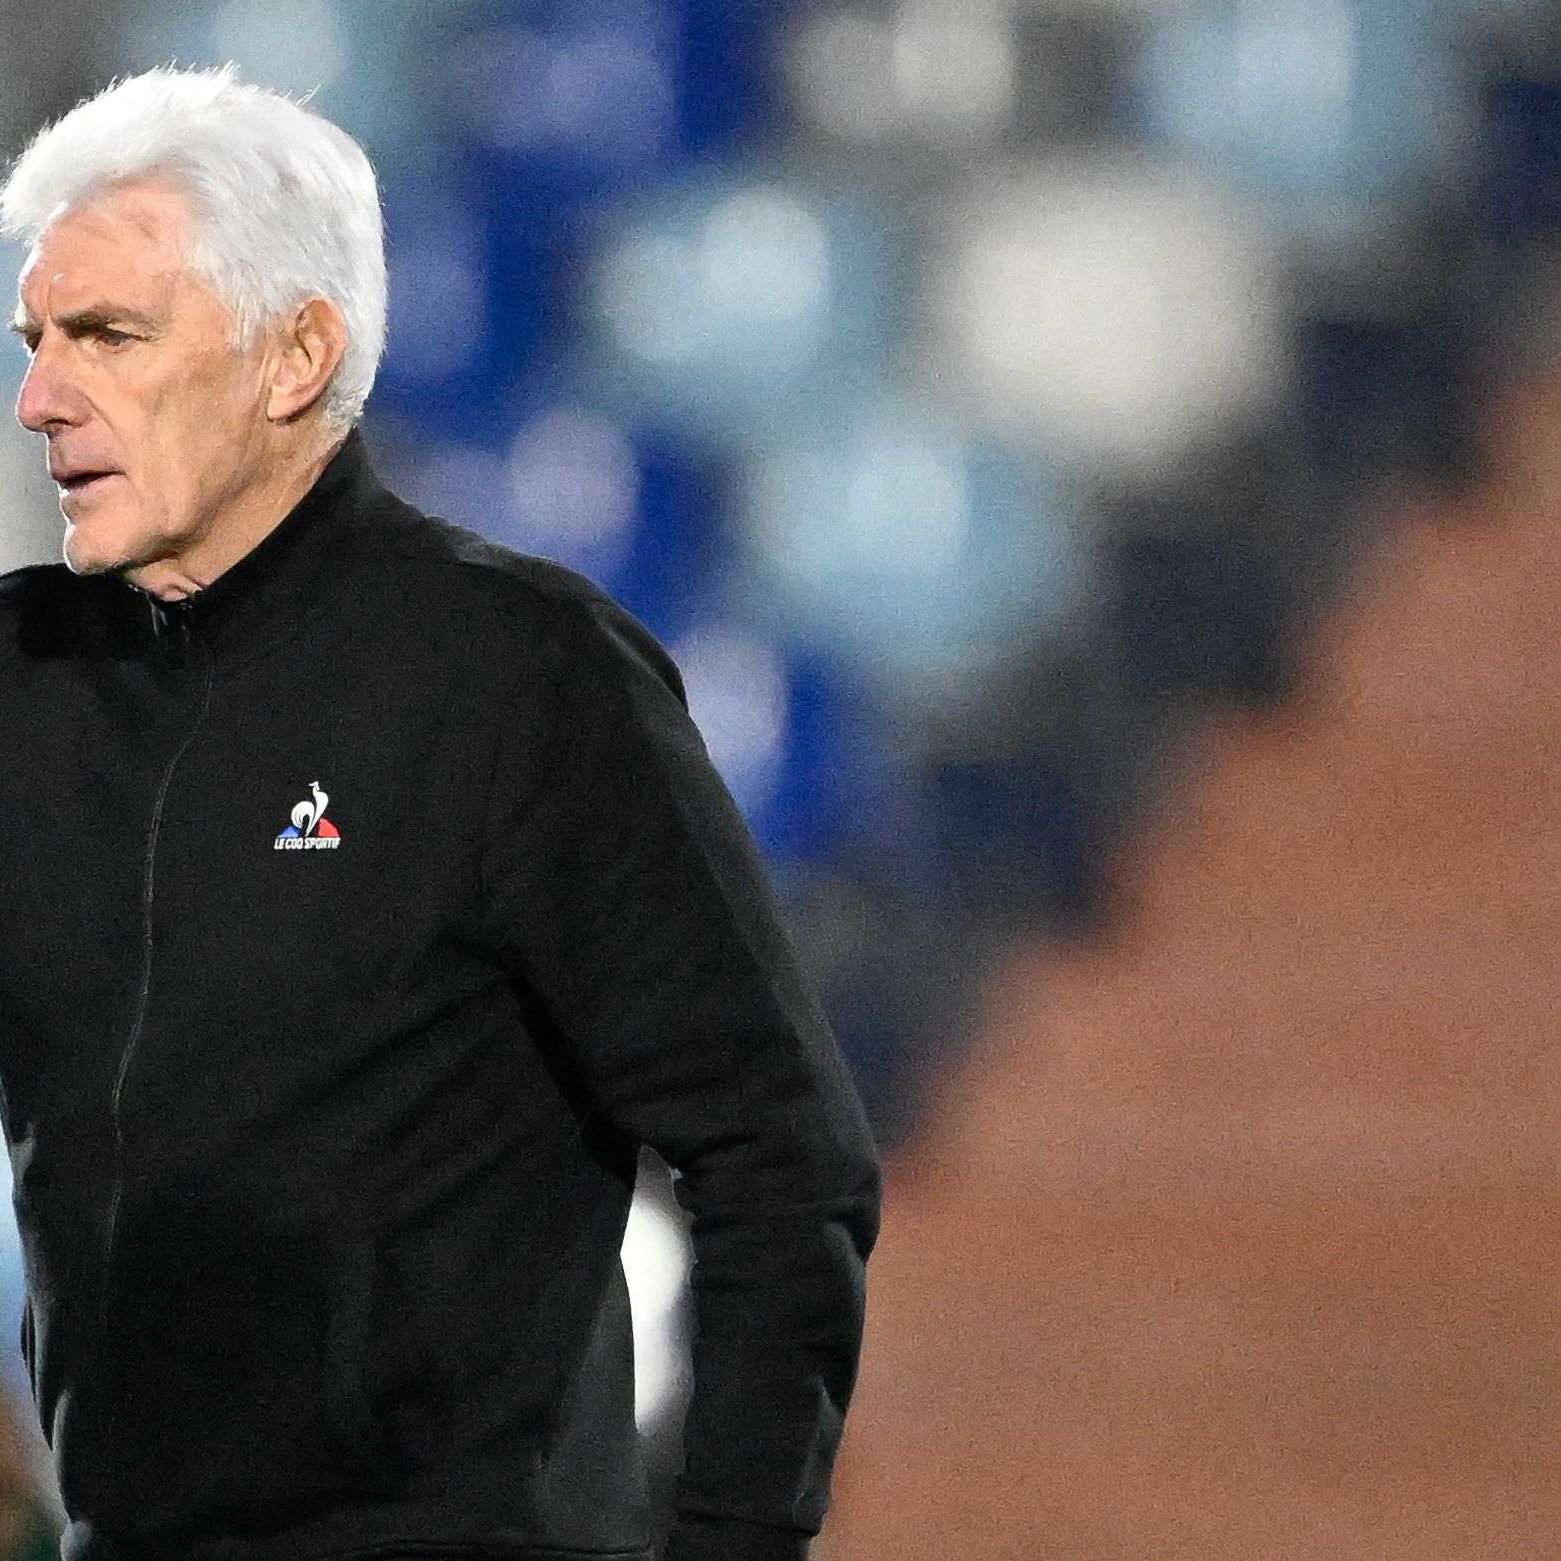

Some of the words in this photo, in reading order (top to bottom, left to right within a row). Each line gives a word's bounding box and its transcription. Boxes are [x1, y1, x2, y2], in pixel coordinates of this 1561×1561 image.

[274, 838, 286, 850] LE
[285, 837, 304, 850] COQ
[304, 837, 341, 850] SPORTIF
